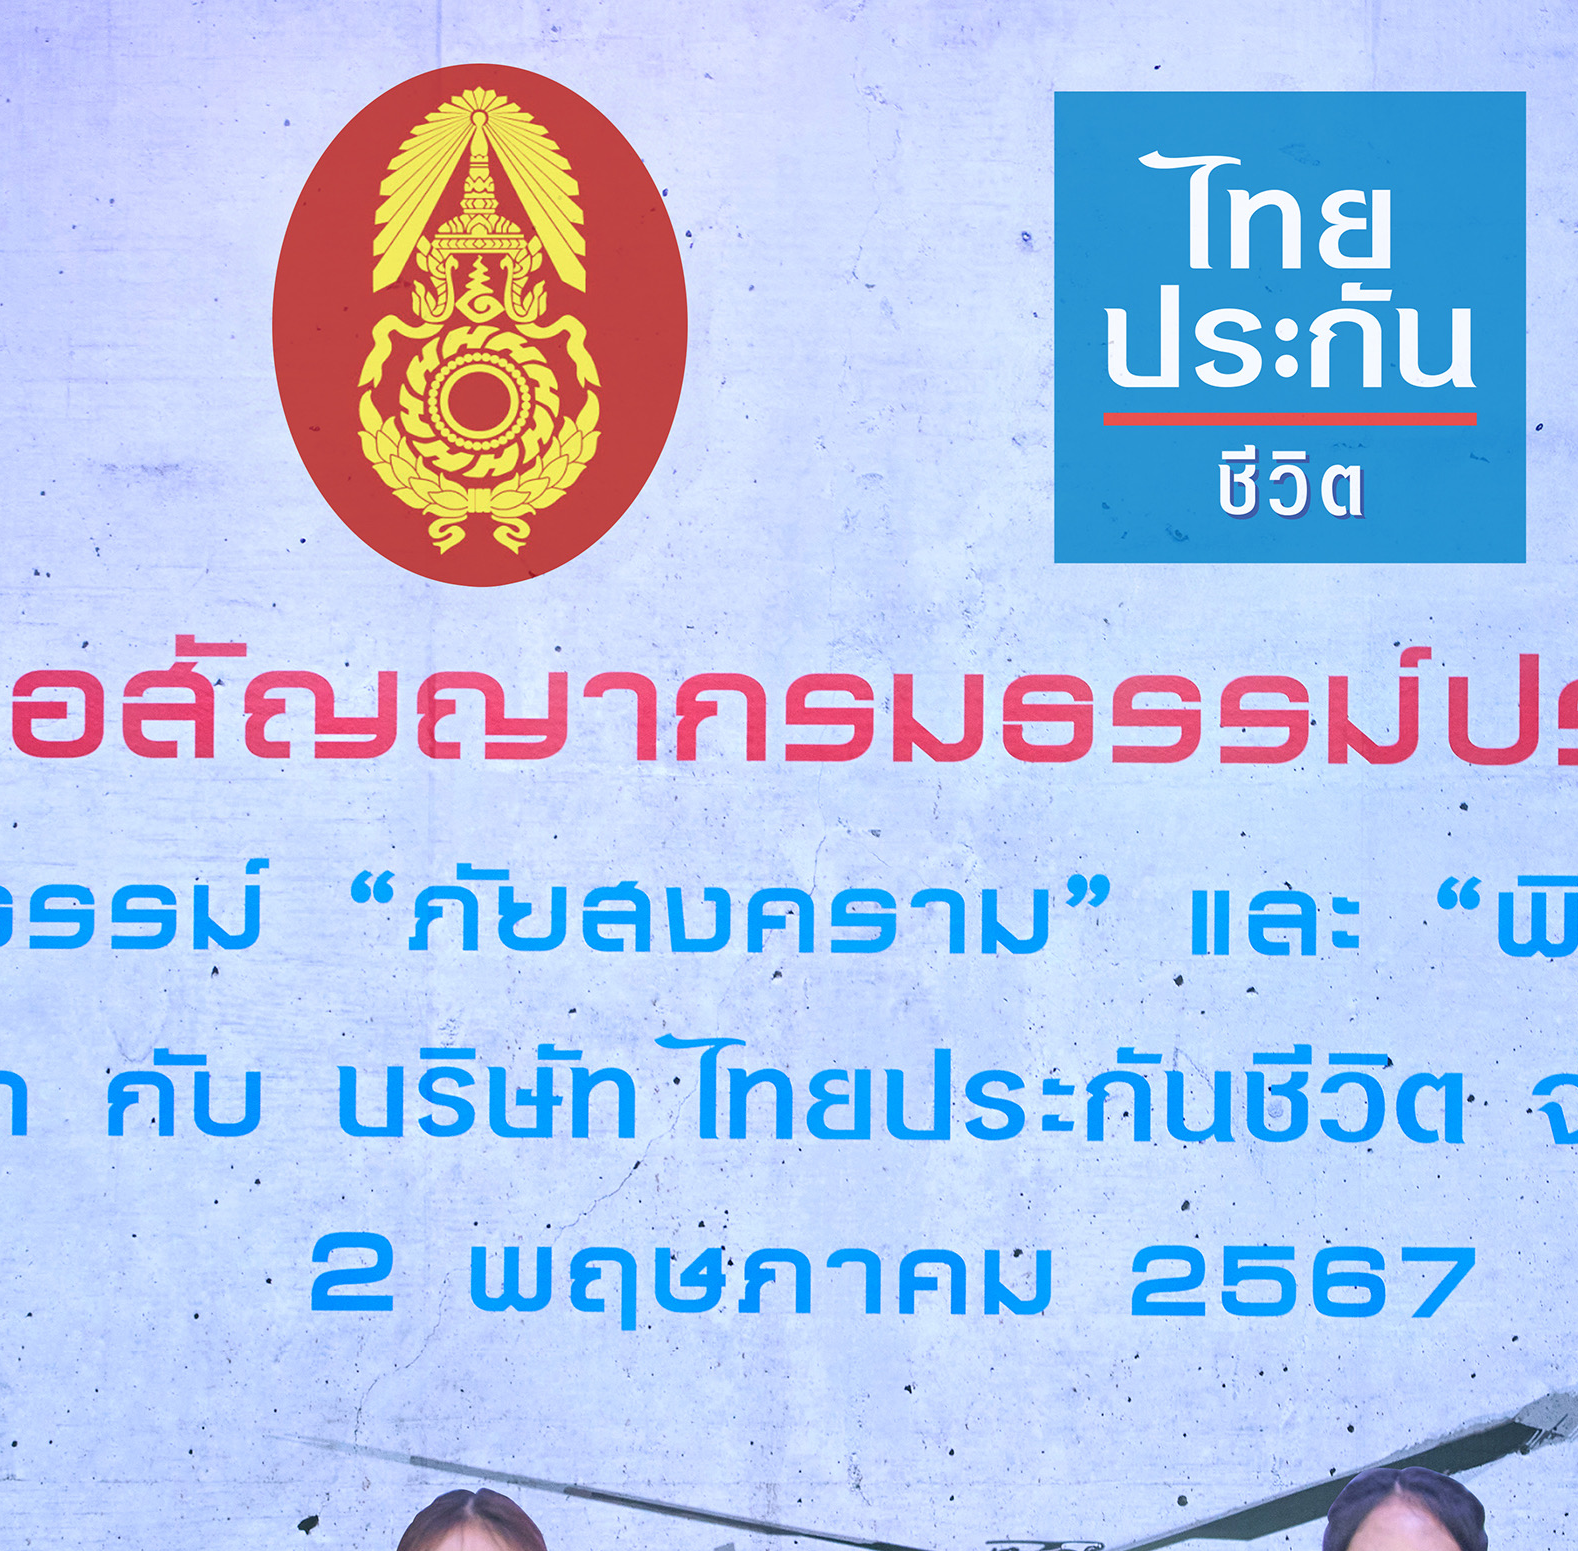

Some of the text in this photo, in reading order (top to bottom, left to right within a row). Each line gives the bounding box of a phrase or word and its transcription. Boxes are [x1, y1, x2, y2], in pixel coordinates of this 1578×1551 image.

[1138, 150, 1391, 269] ไทย
[1104, 282, 1477, 388] ประกัน
[1218, 444, 1364, 518] ชีวิต
[350, 862, 1111, 955] “ภัยสงคราม”
[1191, 889, 1360, 957] และ
[106, 1047, 262, 1138] กับ
[336, 1044, 635, 1140] บริษัท
[654, 1032, 1466, 1145] ไทยประกันชีวิต
[310, 1230, 1476, 1332] 2 พฤษภาคม 2567
